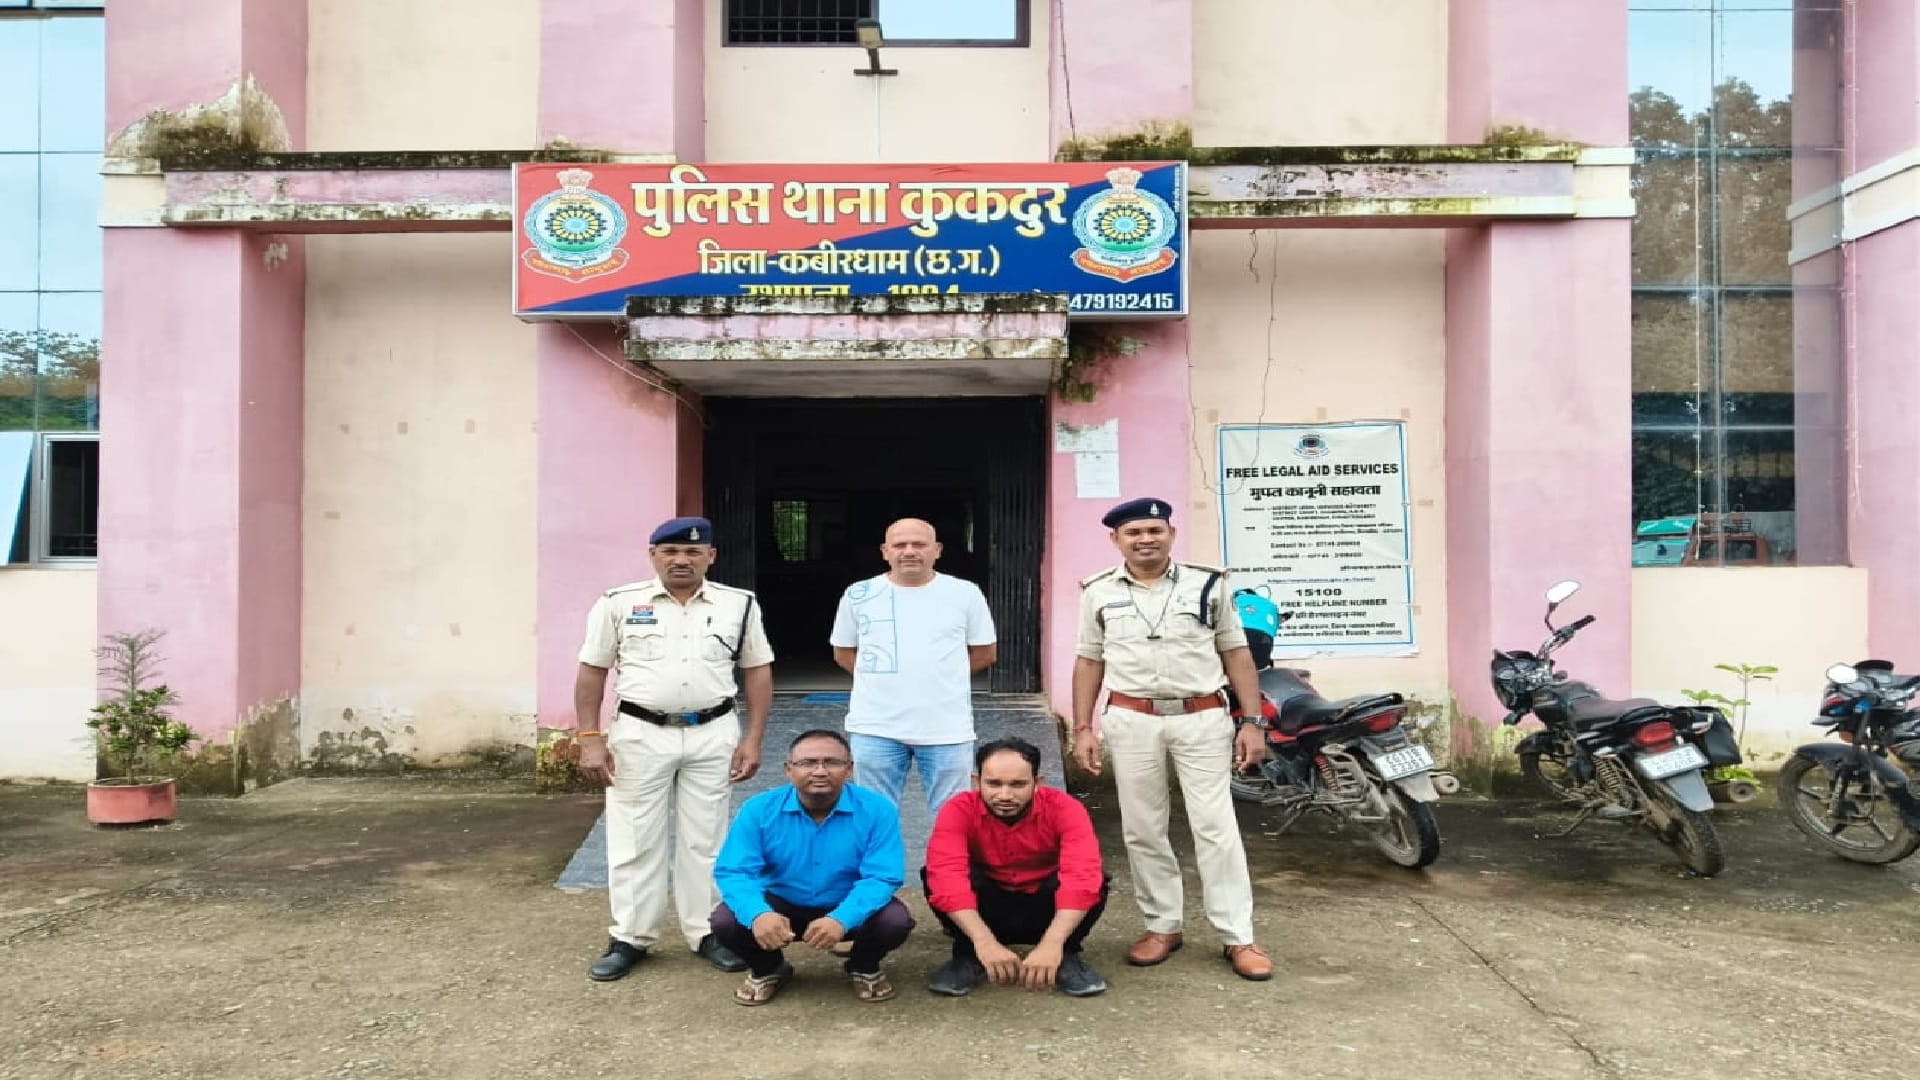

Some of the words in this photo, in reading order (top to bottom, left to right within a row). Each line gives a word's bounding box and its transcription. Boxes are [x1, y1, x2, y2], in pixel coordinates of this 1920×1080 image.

[631, 165, 774, 237] पुलिस
[783, 181, 890, 224] थाना
[898, 182, 1070, 237] कुकदुर
[697, 239, 910, 275] जिला-कबीरधाम
[914, 244, 1000, 276] (छ.ग.)
[1226, 467, 1259, 478] FREE
[1264, 465, 1305, 477] LEGAL
[1308, 464, 1330, 475] AID
[1334, 463, 1399, 475] SERVICES
[1295, 588, 1342, 597] 15100
